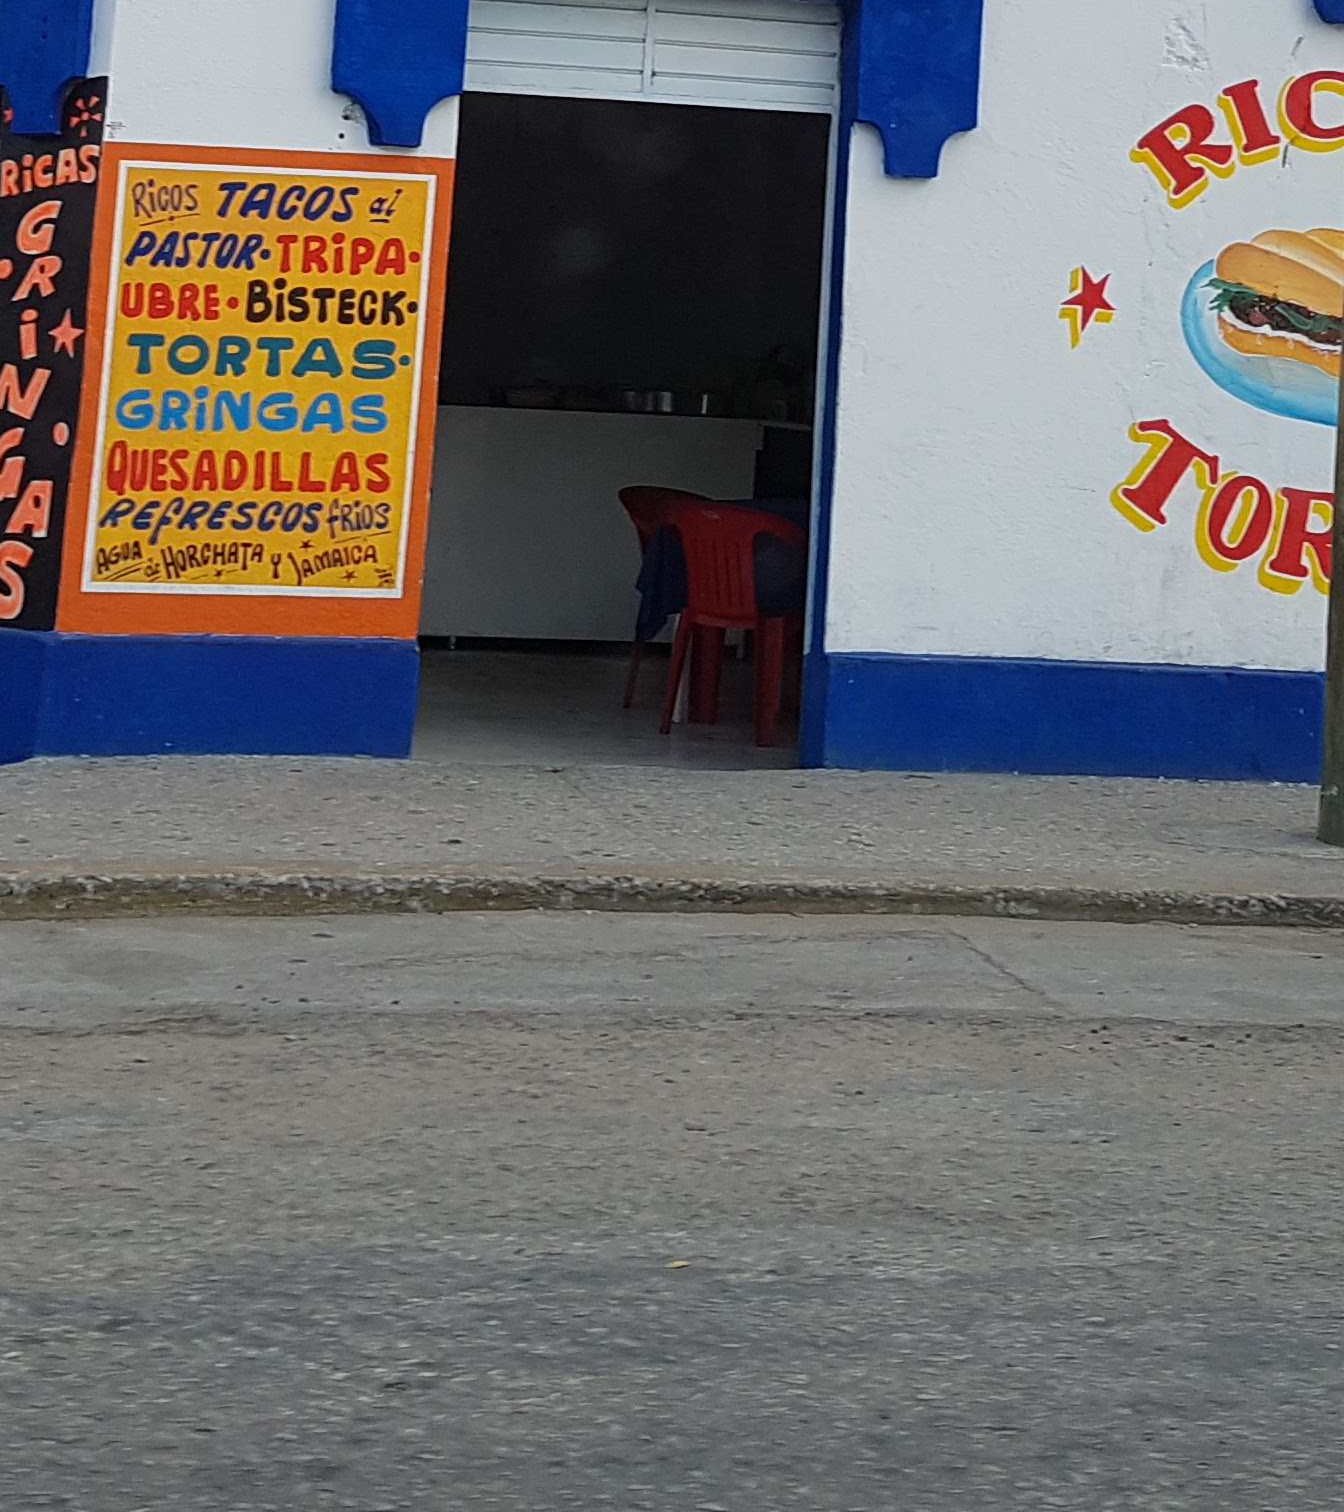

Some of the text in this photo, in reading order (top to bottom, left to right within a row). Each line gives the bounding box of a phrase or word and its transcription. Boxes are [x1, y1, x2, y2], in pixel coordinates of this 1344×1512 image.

[217, 181, 359, 222] TACOS
[124, 230, 265, 270] PASTOR
[120, 282, 220, 321] UBRE
[127, 332, 397, 380] TORTAS
[105, 440, 391, 495] QUESADILLAS
[95, 540, 143, 576] AGUA
[161, 541, 264, 580] HORCHATA
